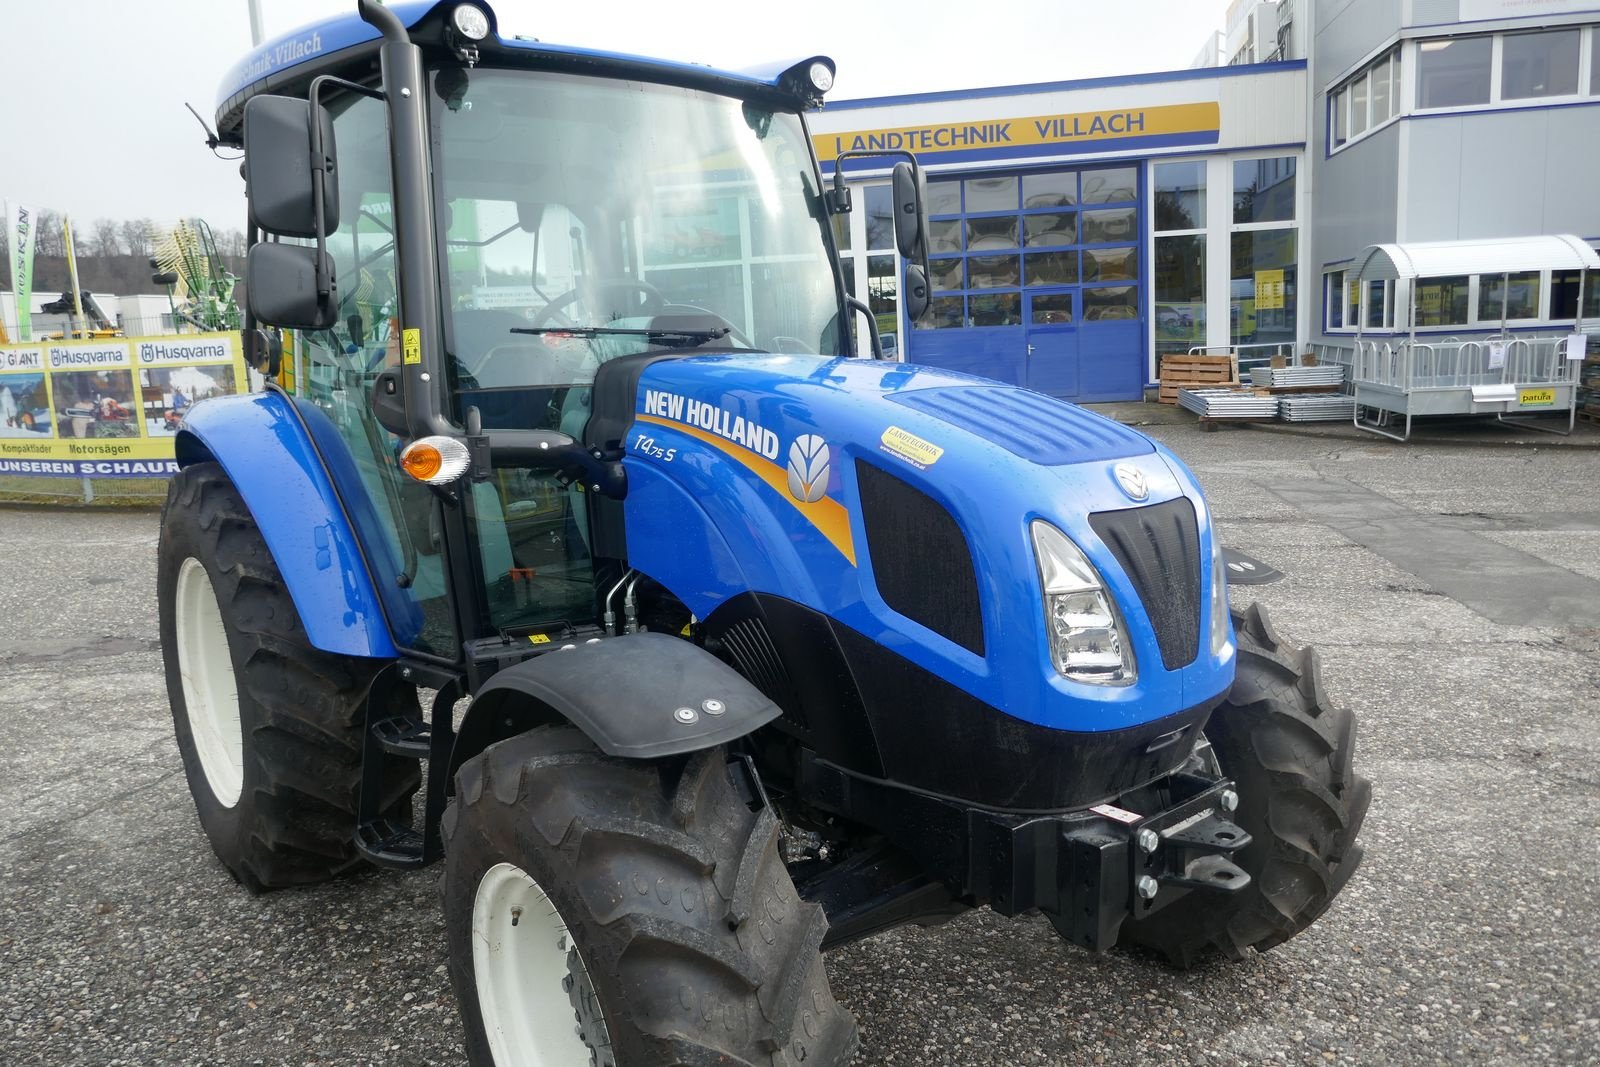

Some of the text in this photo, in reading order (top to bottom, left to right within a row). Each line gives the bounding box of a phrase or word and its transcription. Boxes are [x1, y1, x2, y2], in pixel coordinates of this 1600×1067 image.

[836, 112, 1145, 155] LANDTECHNIK VILLACH
[61, 350, 123, 364] Husqvarna
[155, 345, 225, 360] Husqvarna
[1522, 392, 1551, 403] patura
[644, 390, 779, 460] NEW HOLLAND
[888, 428, 938, 456] LANDTECHNIK
[69, 444, 131, 455] Motorsägen
[664, 448, 677, 462] S
[0, 461, 75, 474] UNSEREN
